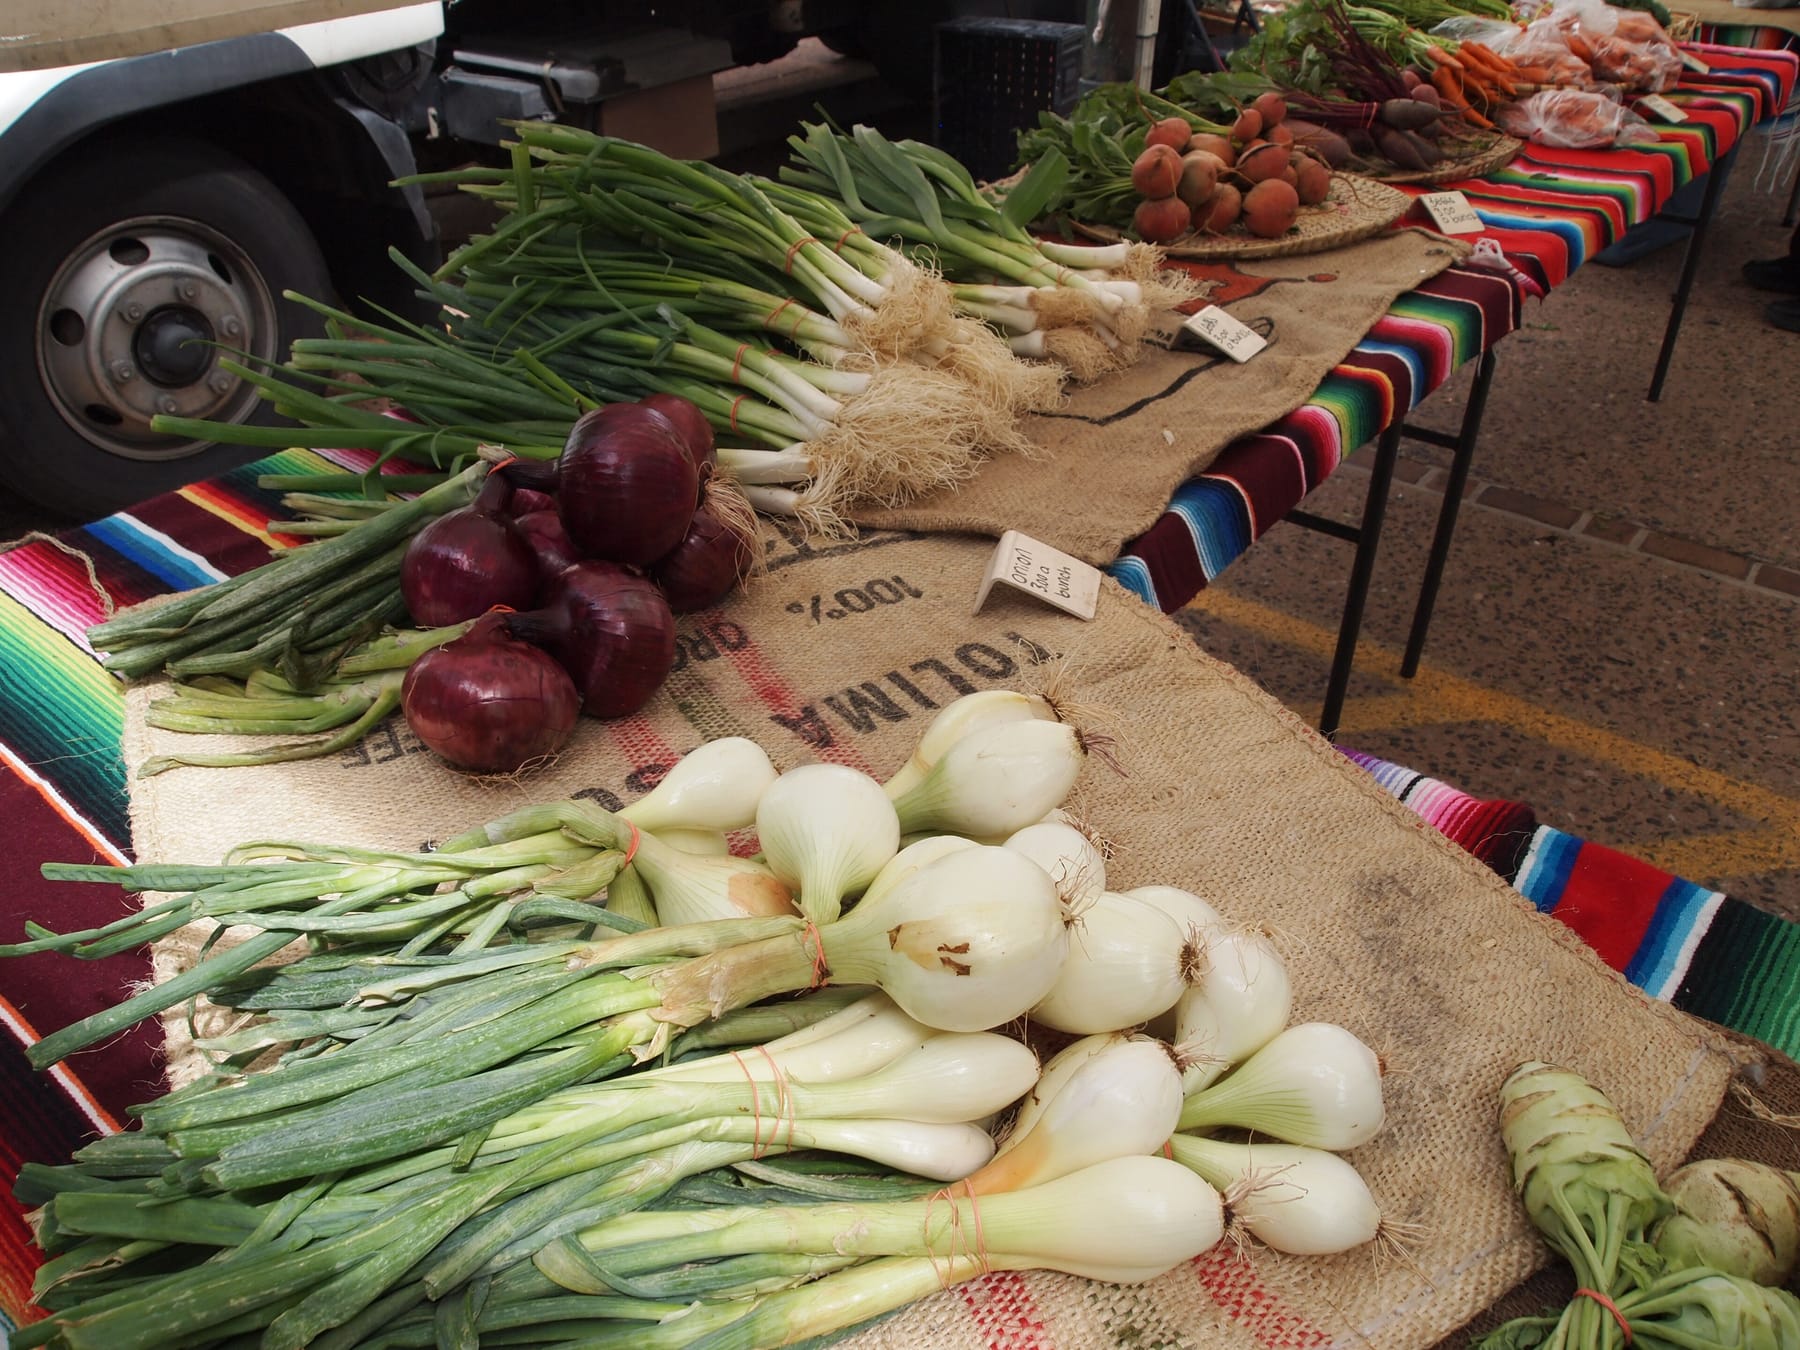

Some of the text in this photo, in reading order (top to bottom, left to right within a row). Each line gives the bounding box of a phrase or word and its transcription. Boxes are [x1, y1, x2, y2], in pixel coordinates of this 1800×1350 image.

[1040, 566, 1050, 575] a
[1054, 566, 1072, 599] bunch
[785, 574, 924, 625] 100%
